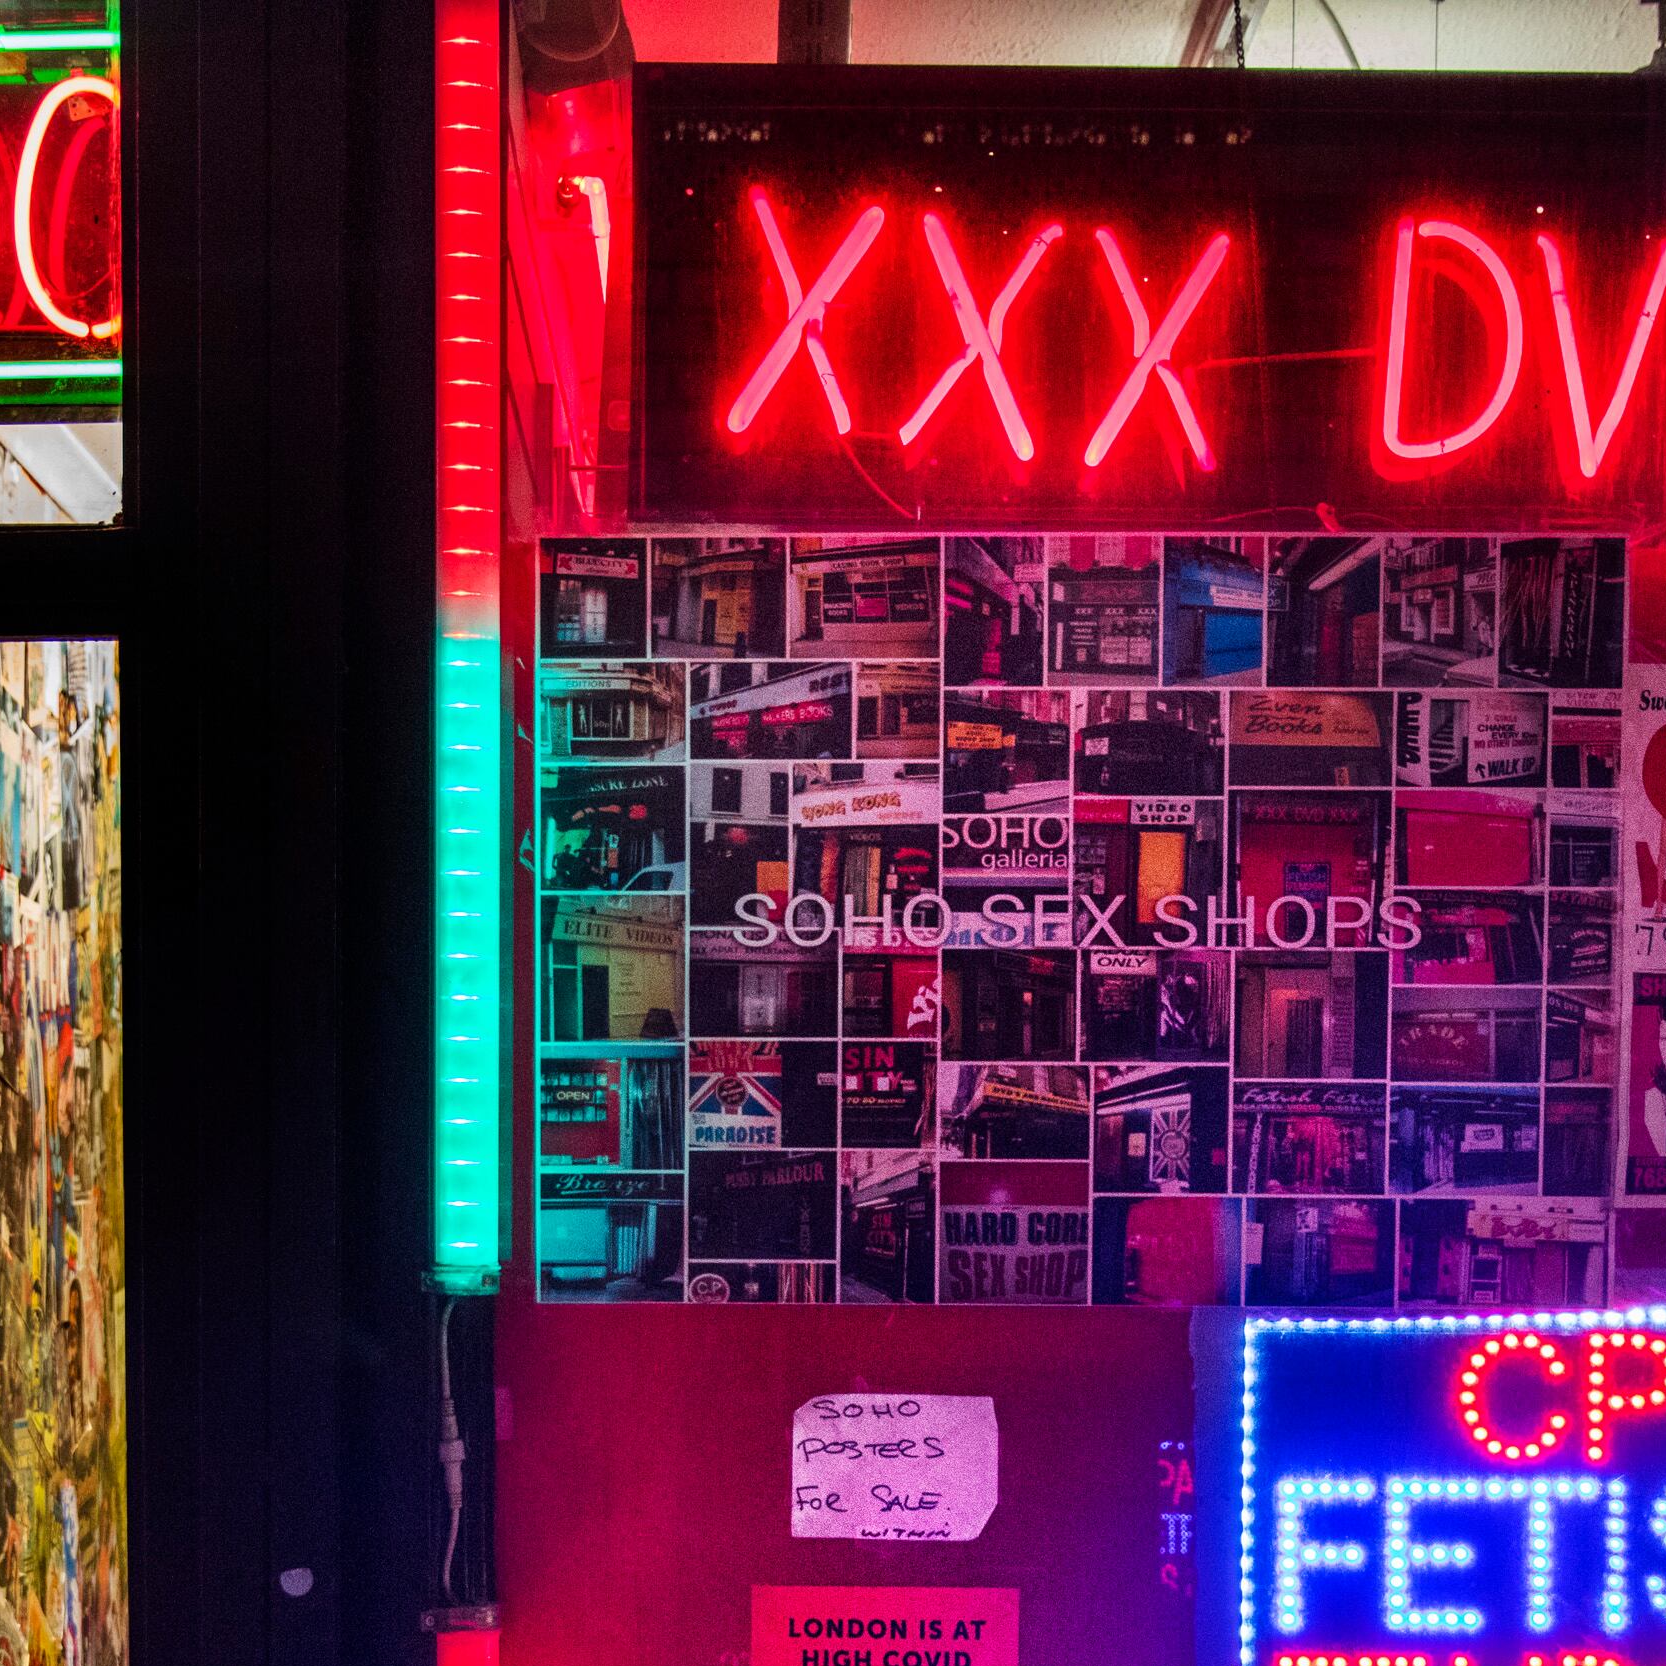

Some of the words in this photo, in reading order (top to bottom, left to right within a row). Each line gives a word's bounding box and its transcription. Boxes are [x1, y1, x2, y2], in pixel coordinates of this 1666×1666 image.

[723, 187, 1231, 472] XXX
[941, 817, 1068, 850] SOHO
[981, 847, 1068, 871] galleria
[733, 892, 951, 949] SOHO
[983, 892, 1126, 950] SEX
[1153, 893, 1423, 951] SHOPS
[944, 1211, 1018, 1245] HARD
[812, 1400, 921, 1422] SOHO
[788, 1618, 908, 1639] LONDON
[919, 1620, 942, 1640] IS
[952, 1620, 987, 1640] AT
